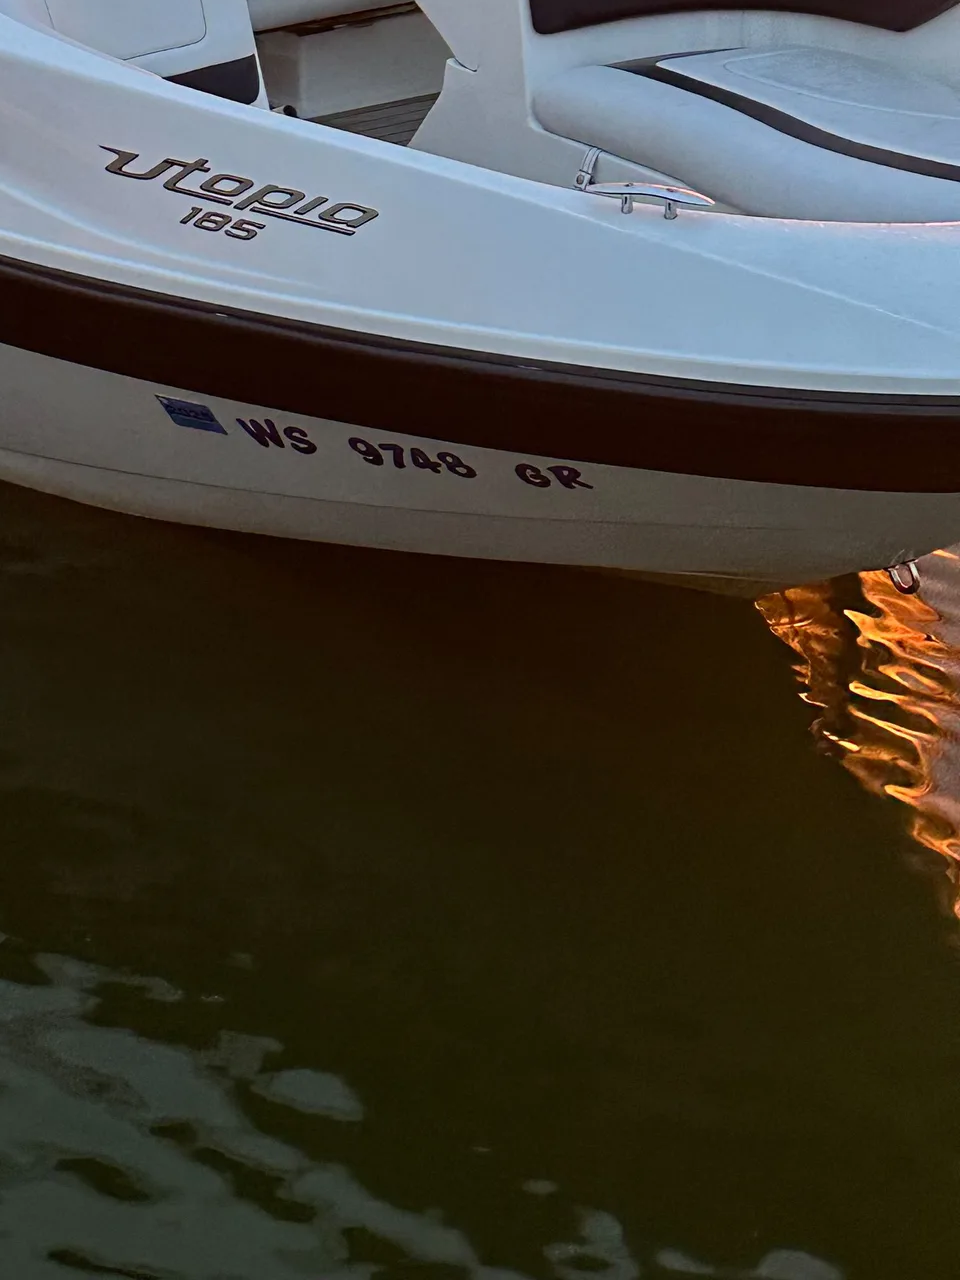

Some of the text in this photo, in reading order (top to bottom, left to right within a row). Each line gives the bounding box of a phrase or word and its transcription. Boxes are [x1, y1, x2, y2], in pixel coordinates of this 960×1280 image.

[179, 206, 266, 241] 185
[235, 418, 594, 489] WS 9748 GR
